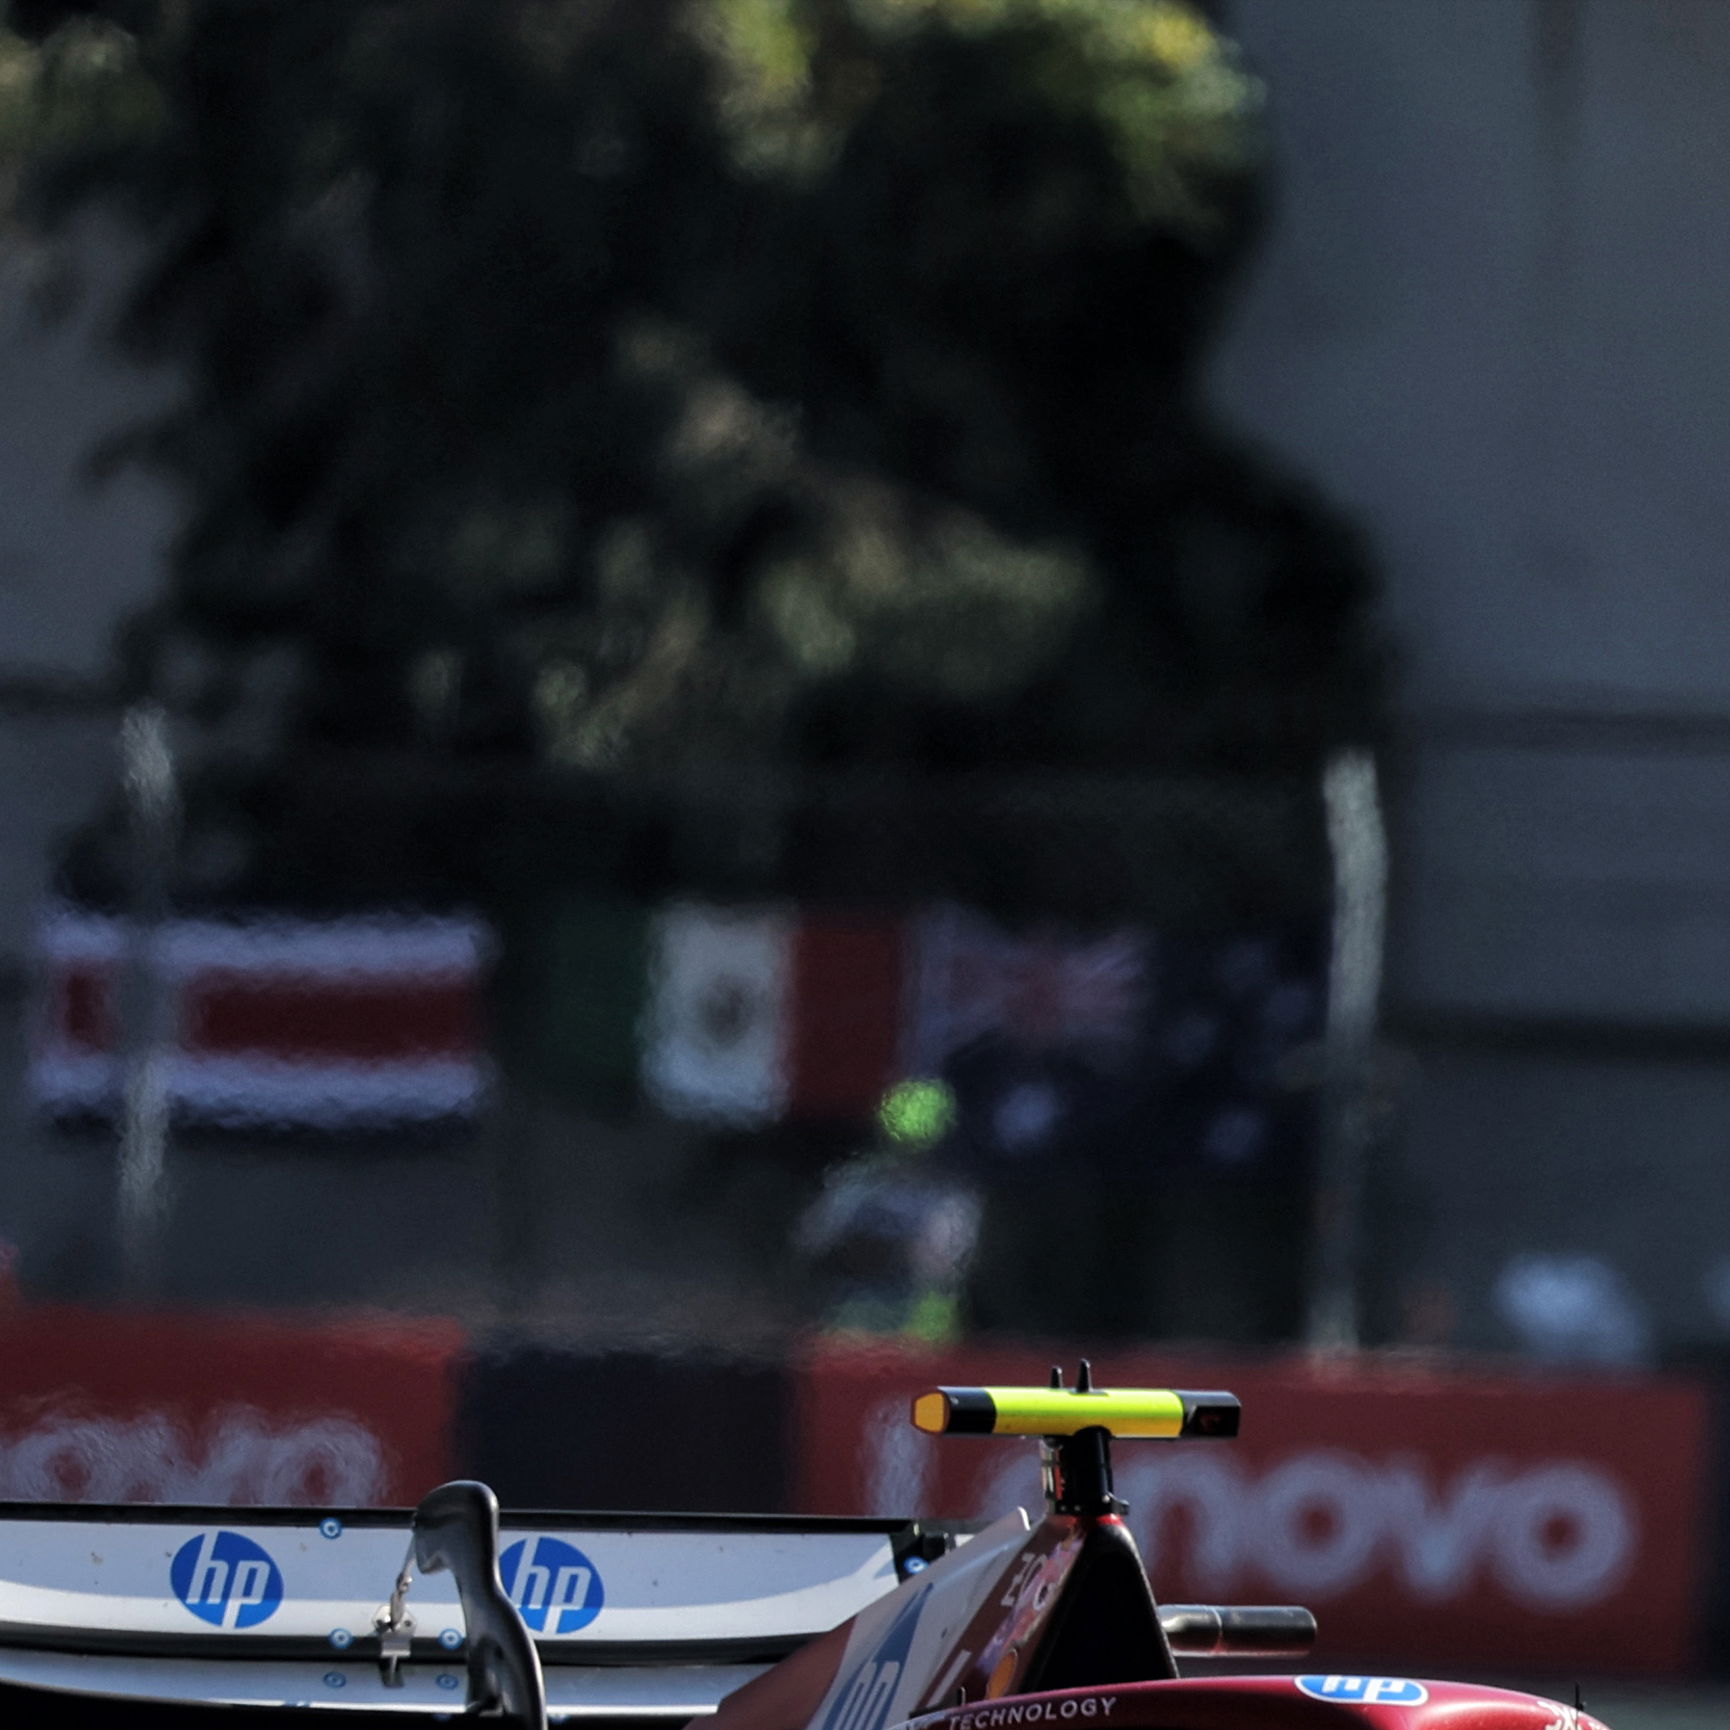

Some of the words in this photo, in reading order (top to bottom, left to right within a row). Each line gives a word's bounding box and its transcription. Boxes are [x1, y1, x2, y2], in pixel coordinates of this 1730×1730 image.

[187, 1531, 270, 1628] hp
[508, 1537, 591, 1633] hp
[1321, 1674, 1402, 1700] hp
